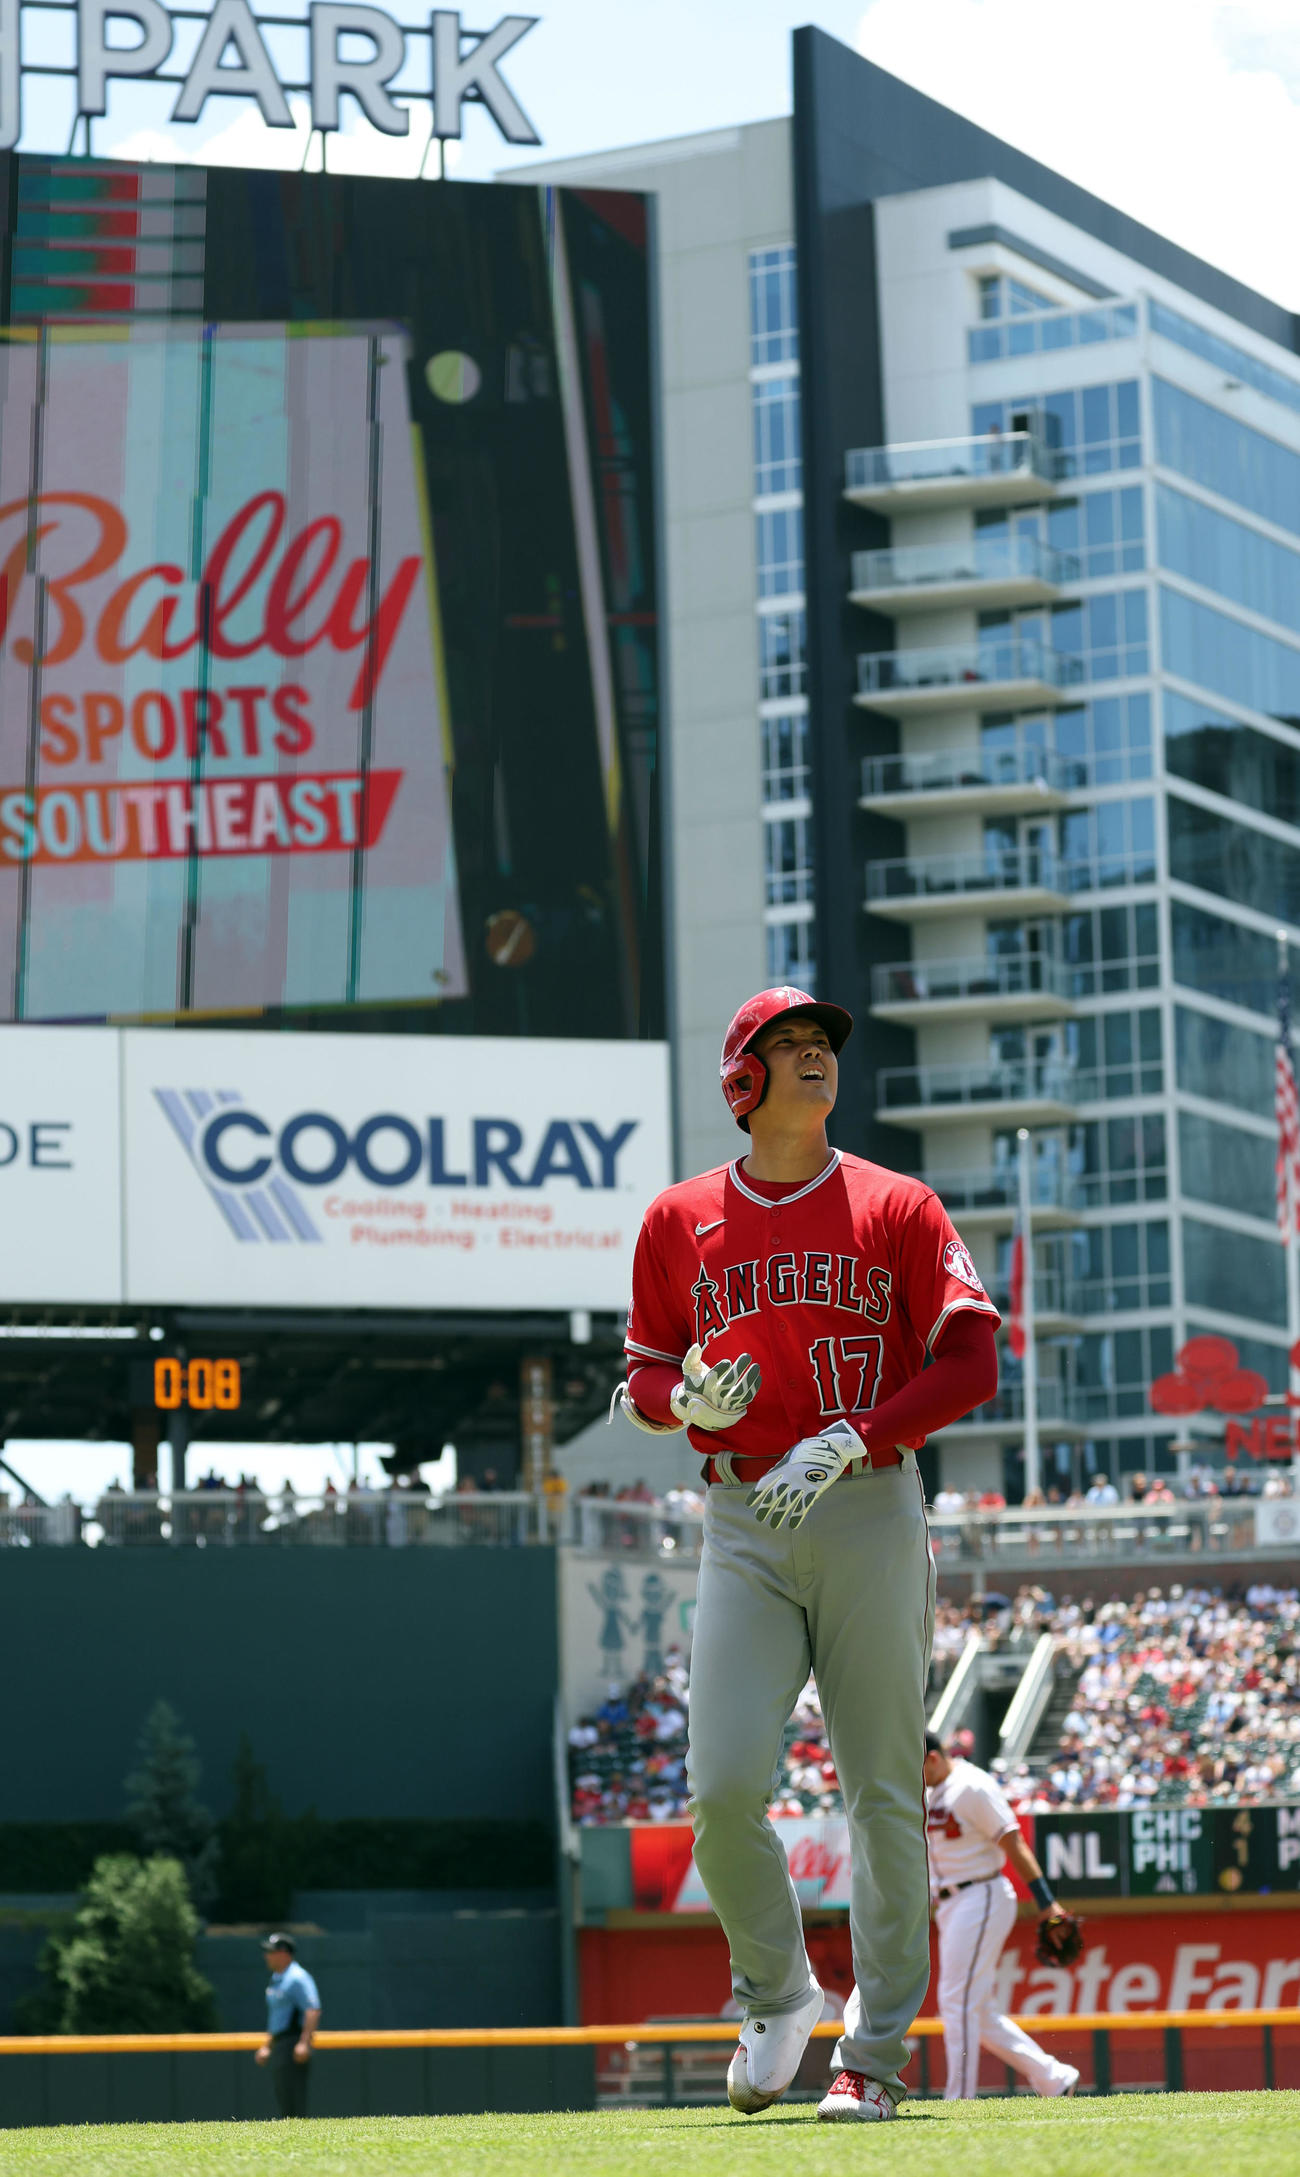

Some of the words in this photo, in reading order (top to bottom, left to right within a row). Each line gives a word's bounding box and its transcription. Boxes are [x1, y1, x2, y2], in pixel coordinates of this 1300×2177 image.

[76, 0, 542, 146] PARK
[0, 490, 424, 711] Bally
[38, 684, 316, 765] SPORTS
[0, 778, 364, 859] SOUTHEAST
[202, 1111, 638, 1190] COOLRAY
[322, 1196, 427, 1223] Cooling
[450, 1199, 554, 1223] Heating
[351, 1226, 475, 1251] Plumbing
[498, 1227, 622, 1249] Electrical
[691, 1251, 893, 1352] ANGELS
[154, 1357, 241, 1411] 0:08
[808, 1334, 884, 1416] 17
[1225, 1415, 1300, 1461] NE
[1046, 1831, 1117, 1879] NL
[1131, 1809, 1203, 1842] CHC
[1133, 1840, 1192, 1873] PHI
[994, 1945, 1161, 2016] tate
[1164, 1942, 1300, 2015] Far
